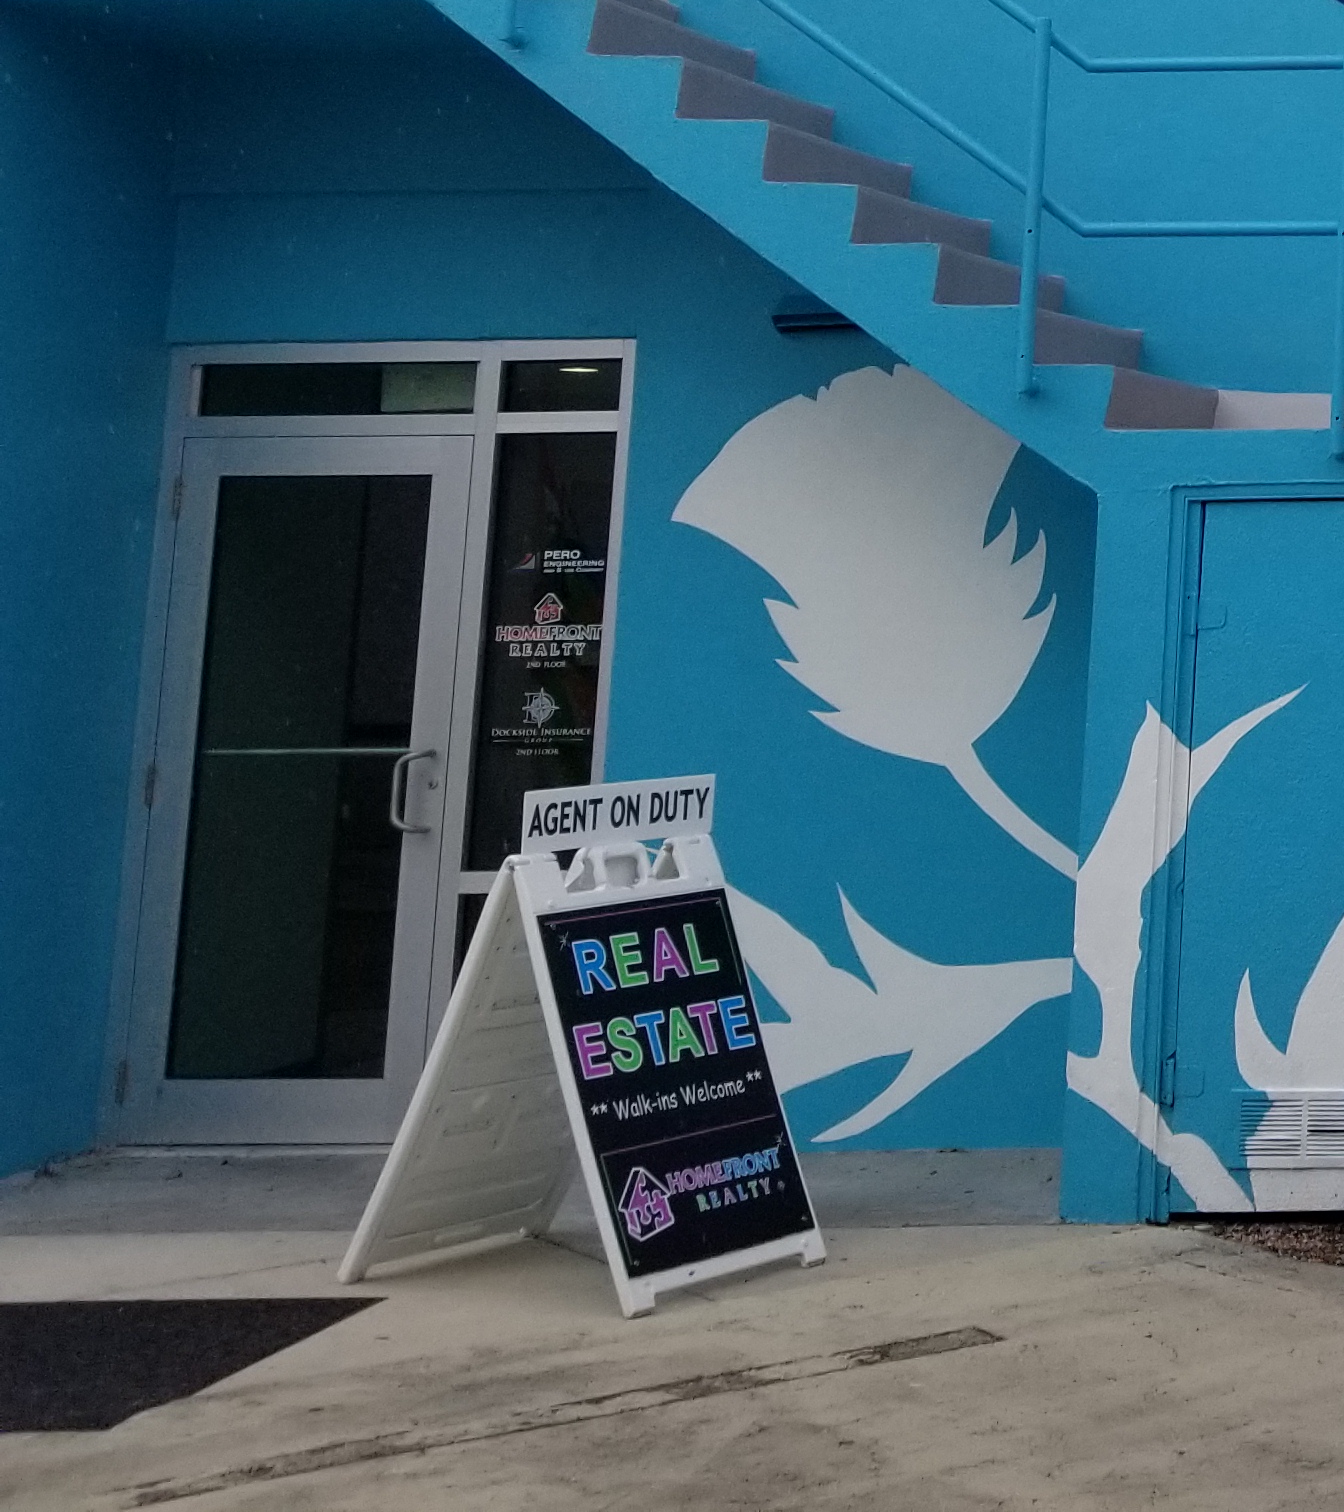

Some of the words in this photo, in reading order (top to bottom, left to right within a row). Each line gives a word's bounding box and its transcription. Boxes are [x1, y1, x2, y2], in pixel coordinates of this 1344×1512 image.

[543, 549, 581, 560] PERO
[543, 560, 605, 568] ENGINEERING
[494, 624, 603, 642] HOMEFRONT
[508, 642, 587, 657] REALTY
[527, 797, 604, 838] AGENT
[610, 794, 641, 829] ON
[649, 787, 711, 825] DUTY
[571, 923, 720, 996] REAL
[572, 995, 757, 1081] ESTATE
[612, 1092, 679, 1122] Walk-ins
[679, 1079, 747, 1107] Welcome
[665, 1147, 781, 1196] HOMEFRONT
[695, 1176, 772, 1213] REALTY
